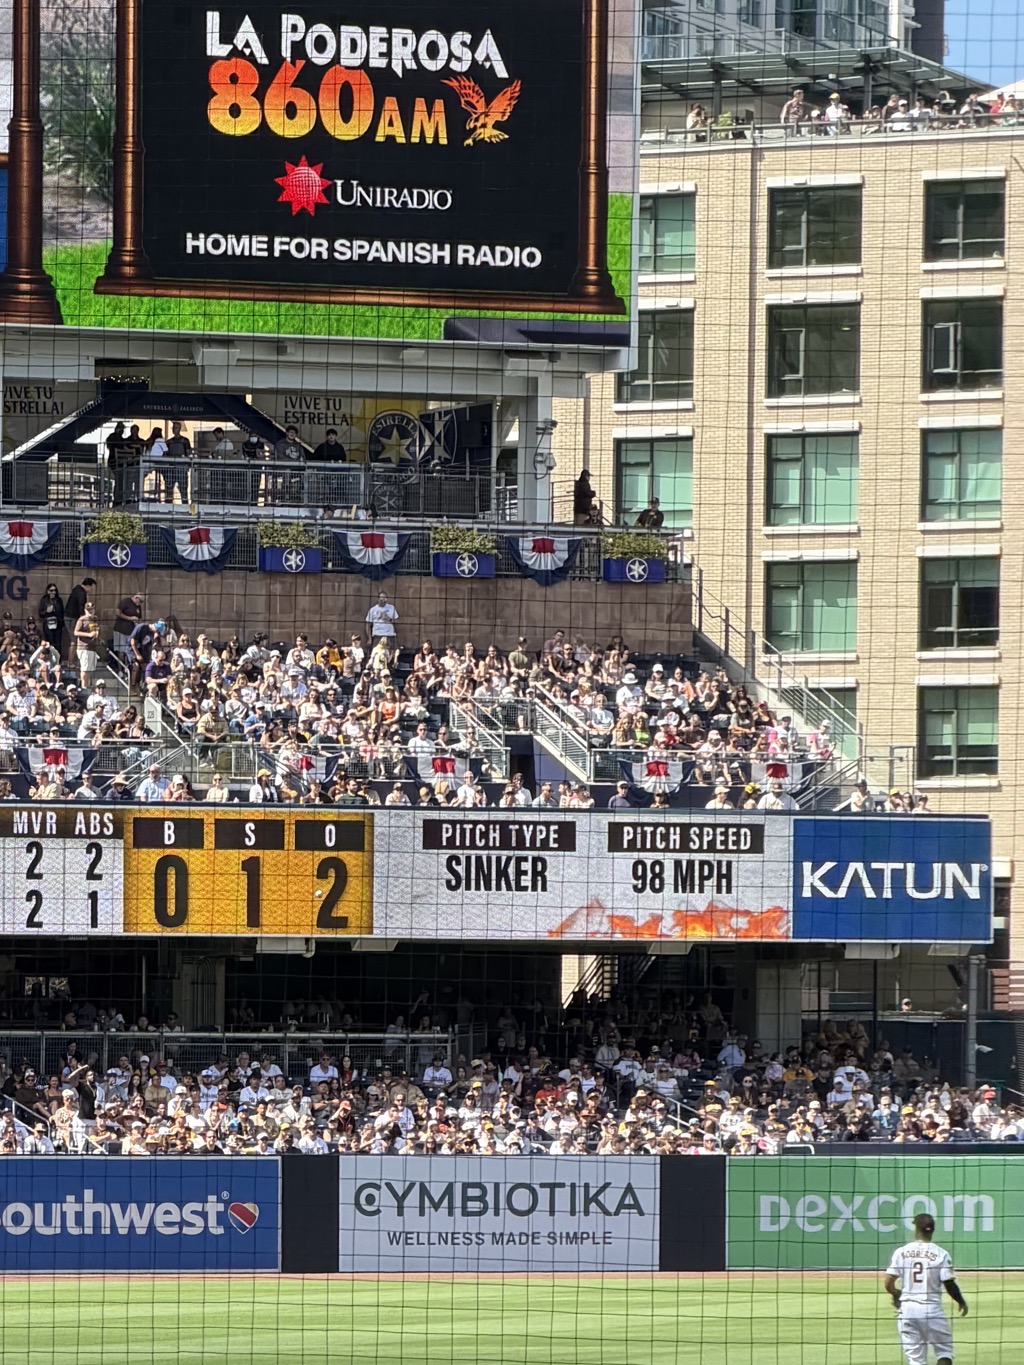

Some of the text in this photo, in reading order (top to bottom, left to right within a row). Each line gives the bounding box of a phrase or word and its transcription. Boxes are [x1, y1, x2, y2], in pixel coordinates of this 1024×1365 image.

[206, 11, 509, 79] LA PODEROSA
[186, 232, 542, 268] HOME FOR SPANISH RADIO
[3, 386, 53, 399] IVE TU
[324, 398, 342, 411] TU
[3, 400, 65, 415] STRELLA!
[13, 811, 57, 834] MVR
[75, 811, 113, 835] ABS
[164, 823, 174, 845] B
[245, 823, 255, 845] S
[325, 824, 335, 846] O
[442, 824, 559, 848] PITCH TYPE
[623, 827, 751, 851] PITCH SPEED
[25, 841, 43, 880] 2
[85, 842, 103, 881] 2
[446, 855, 547, 893] SINKER
[154, 855, 188, 928] 0
[241, 856, 260, 928] 1
[632, 860, 732, 895] 98 MPH
[802, 862, 981, 900] KATUN
[316, 857, 349, 929] 2
[25, 890, 43, 929] 2
[88, 891, 99, 929] 1
[354, 1182, 645, 1217] CYMBIOTIKA
[388, 1230, 613, 1246] WELLNESS MADE SIMPLE
[913, 1262, 923, 1283] 2
